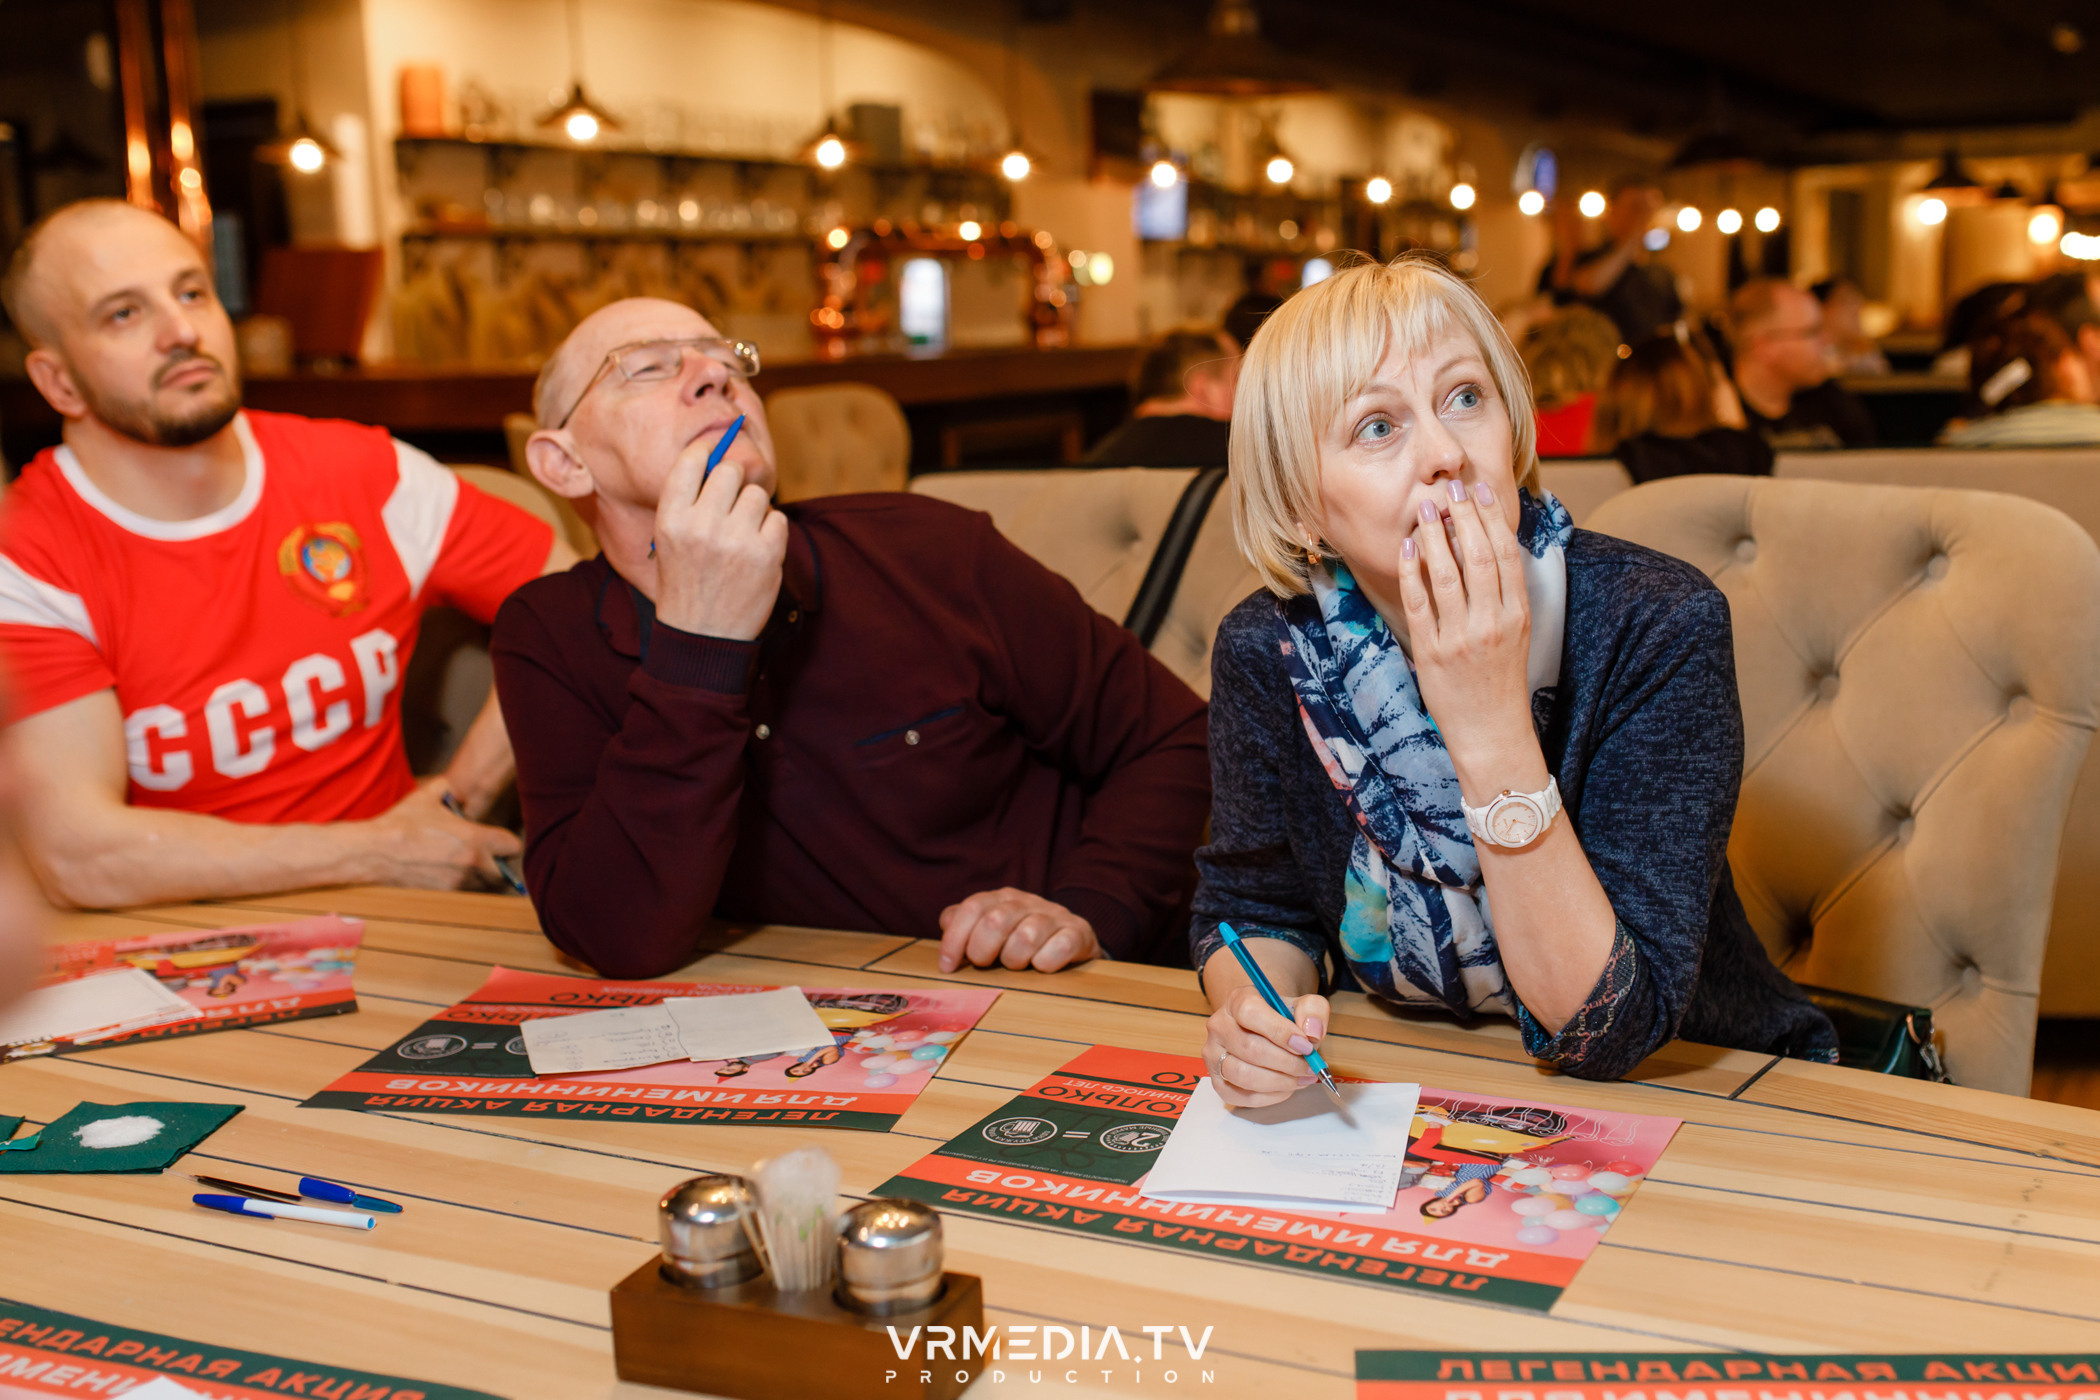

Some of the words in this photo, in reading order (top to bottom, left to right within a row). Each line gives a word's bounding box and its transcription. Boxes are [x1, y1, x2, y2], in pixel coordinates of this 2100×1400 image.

[125, 628, 398, 791] СССР
[550, 992, 664, 1006] ЛЬКО
[385, 1079, 746, 1103] ИМЕНИННИКОВ
[1062, 1079, 1100, 1090] ЛЕТ
[1102, 1084, 1191, 1102] ЛНИЛОСЬ
[364, 1095, 512, 1110] АКЦИЯ
[521, 1101, 840, 1121] ЛЕГЕНДАРНАЯ
[753, 1094, 858, 1106] ДЛЯ
[1038, 1086, 1186, 1115] ОЛЬКО
[1131, 1132, 1161, 1147] 2
[941, 1188, 1103, 1224] АКЦИЯ
[966, 1169, 1374, 1246] ИМЕНИННИКОВ
[1113, 1217, 1488, 1291] ЛЕГЕНДАРНАЯ
[1382, 1237, 1509, 1268] ДЛЯ
[1437, 1359, 1897, 1382] ЛЕГЕНДАРНАЯ
[1924, 1361, 2100, 1384] АКЦИ
